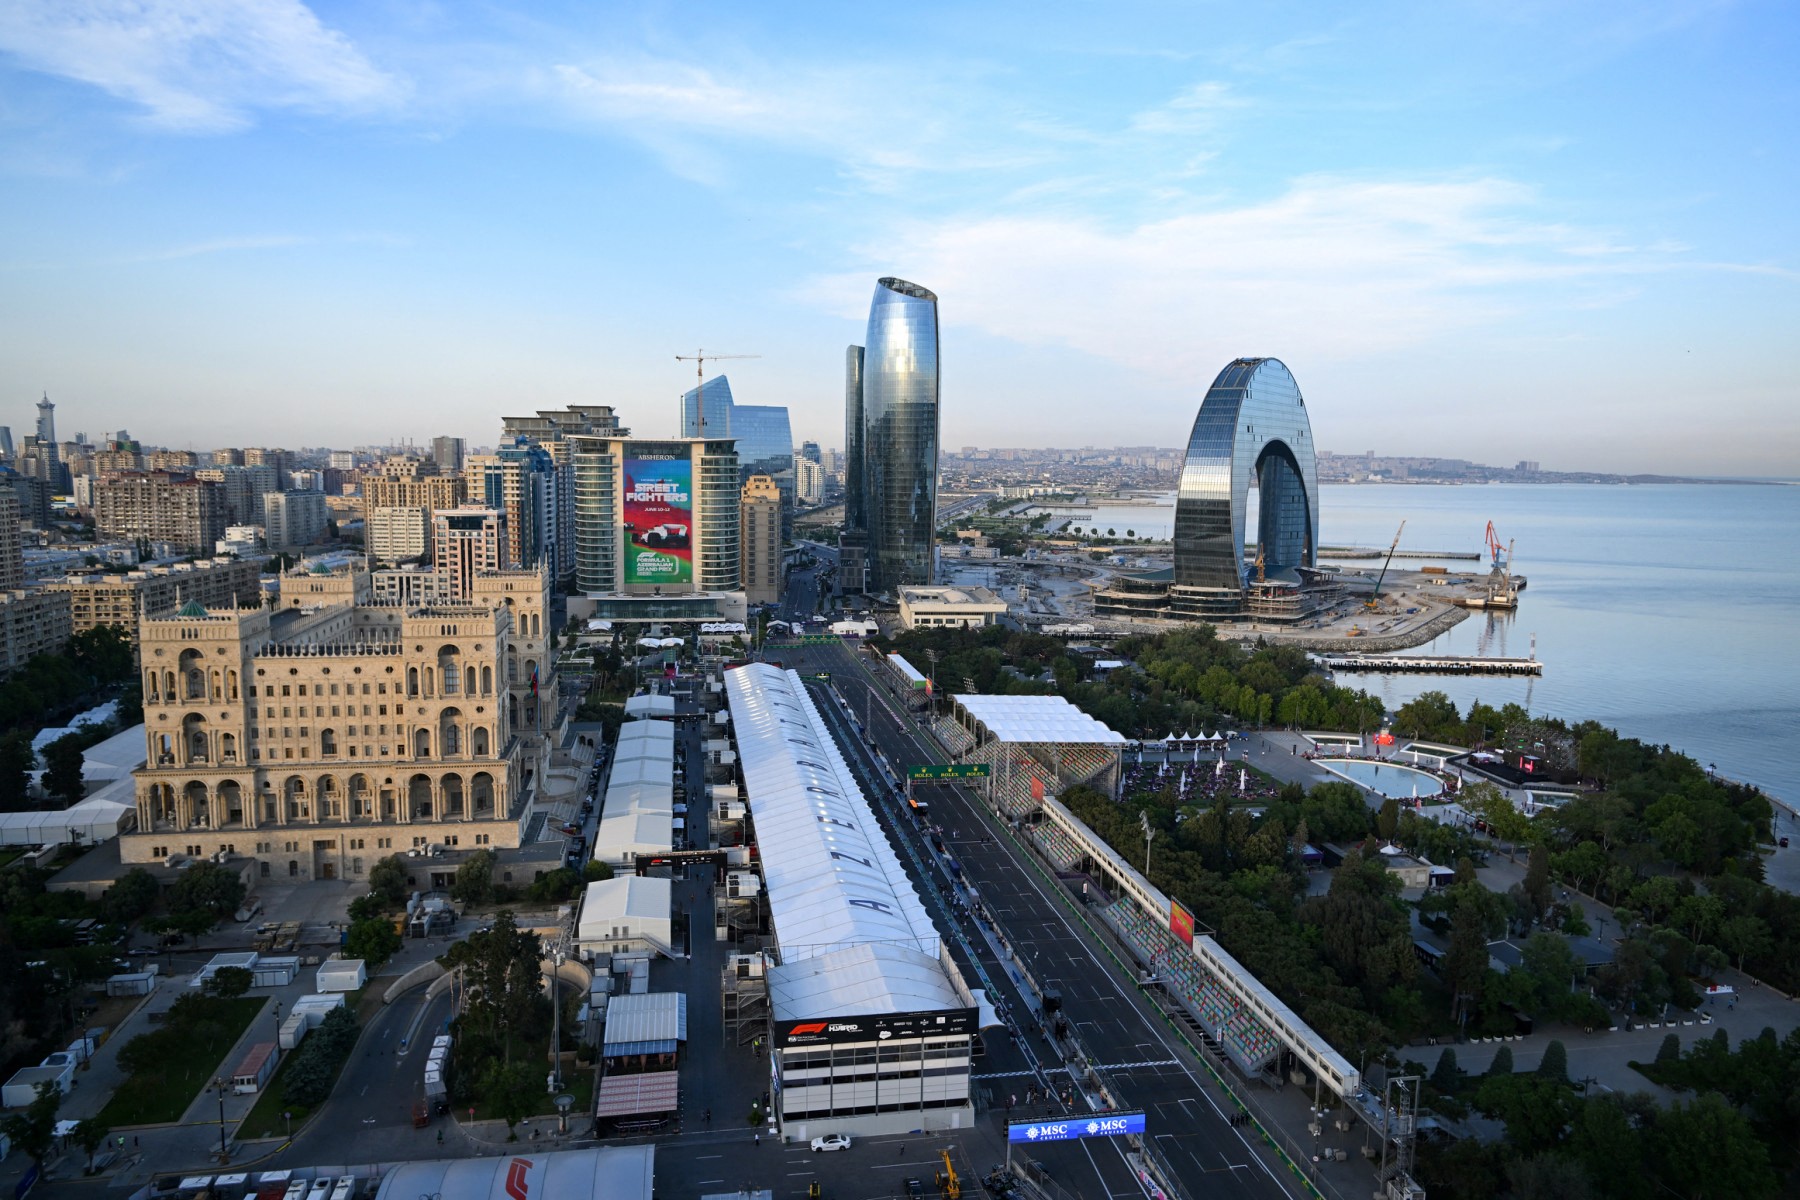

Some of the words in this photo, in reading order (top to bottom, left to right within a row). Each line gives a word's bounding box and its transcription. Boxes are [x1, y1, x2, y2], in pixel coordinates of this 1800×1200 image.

[635, 483, 679, 492] STREET
[626, 492, 688, 501] FIGHTERS
[1100, 1120, 1127, 1130] MSC
[1040, 1124, 1068, 1136] MSC
